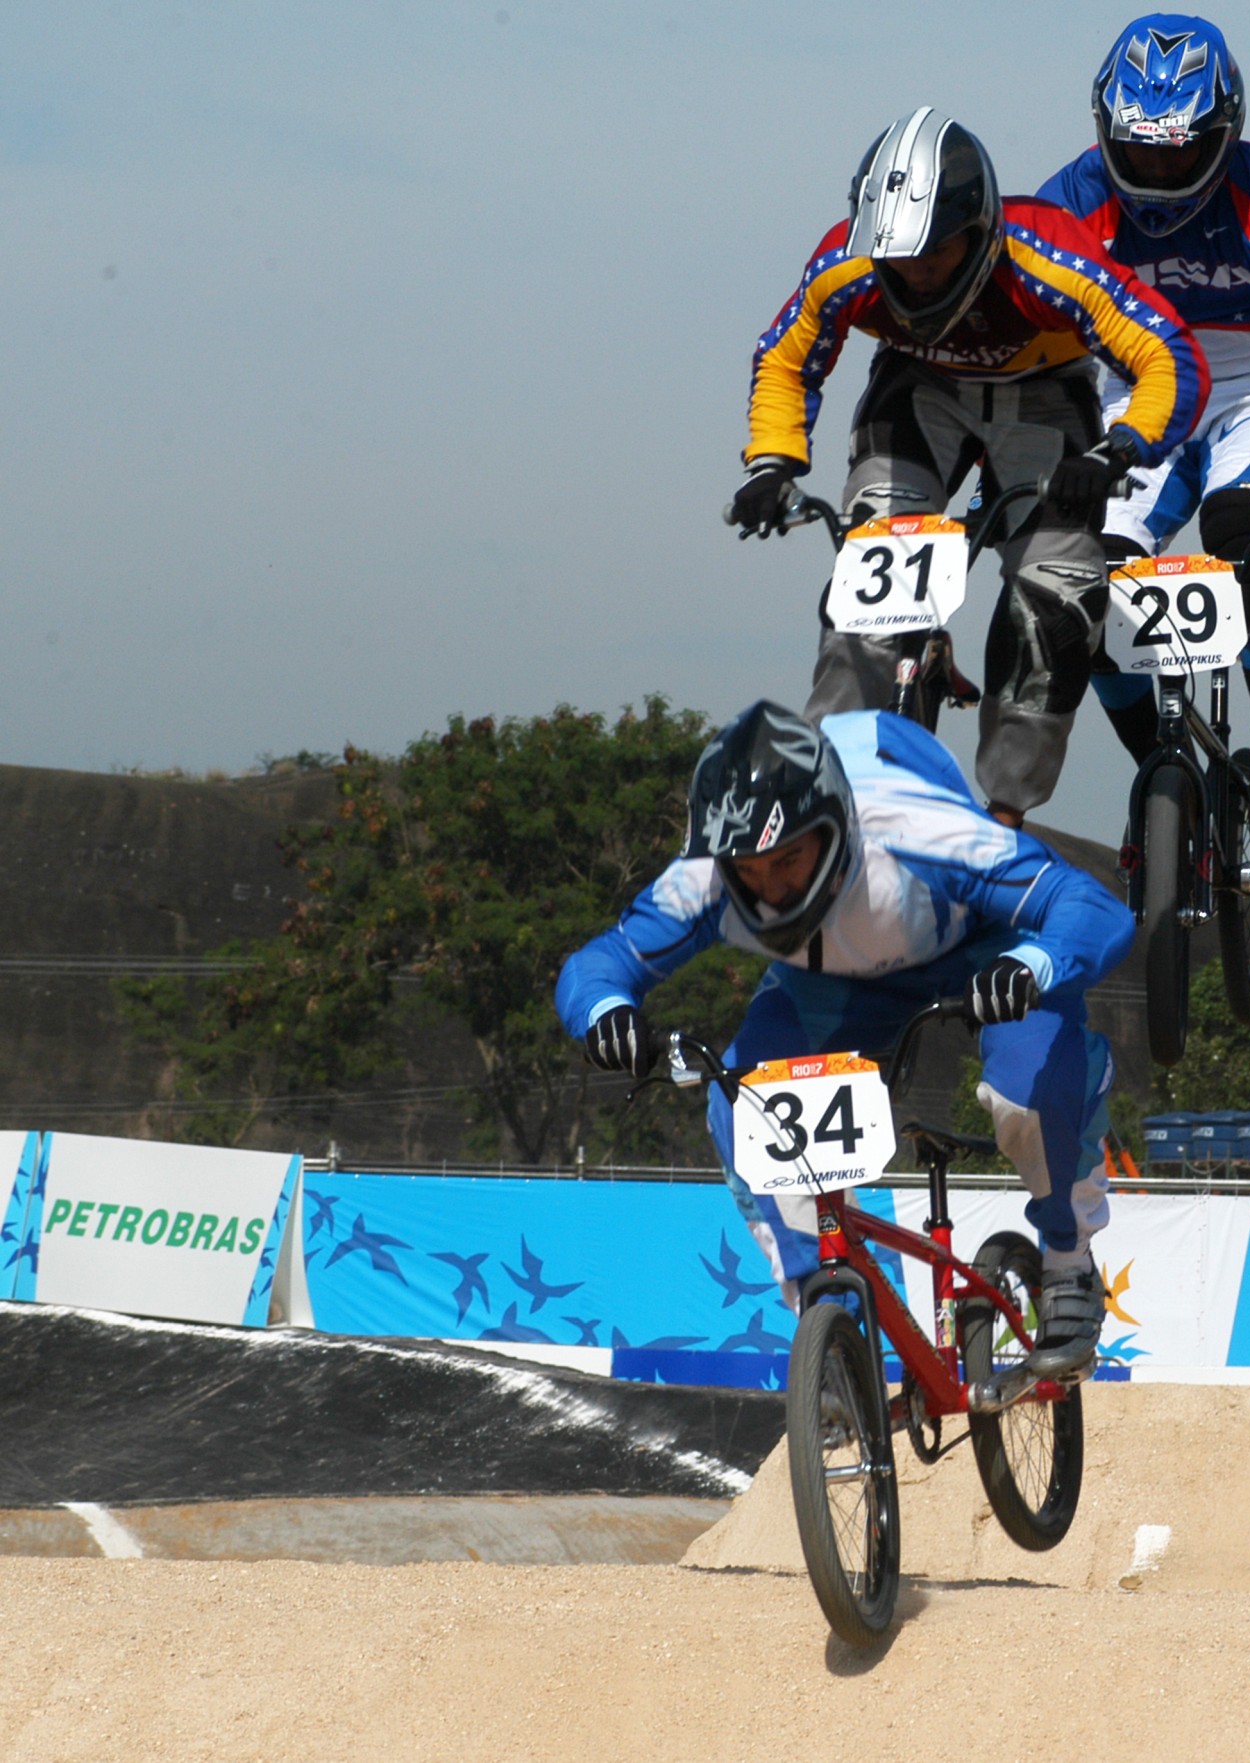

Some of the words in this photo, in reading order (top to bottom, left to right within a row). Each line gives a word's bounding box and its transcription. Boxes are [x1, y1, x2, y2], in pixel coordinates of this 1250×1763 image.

[856, 543, 935, 605] 31
[874, 614, 935, 626] OLYMPIKUS
[1131, 582, 1217, 647] 29
[1161, 654, 1223, 667] OLYMPIKUS
[764, 1084, 864, 1162] 34
[797, 1168, 866, 1185] OLYMPIKUS
[45, 1199, 265, 1255] PETROBRAS
